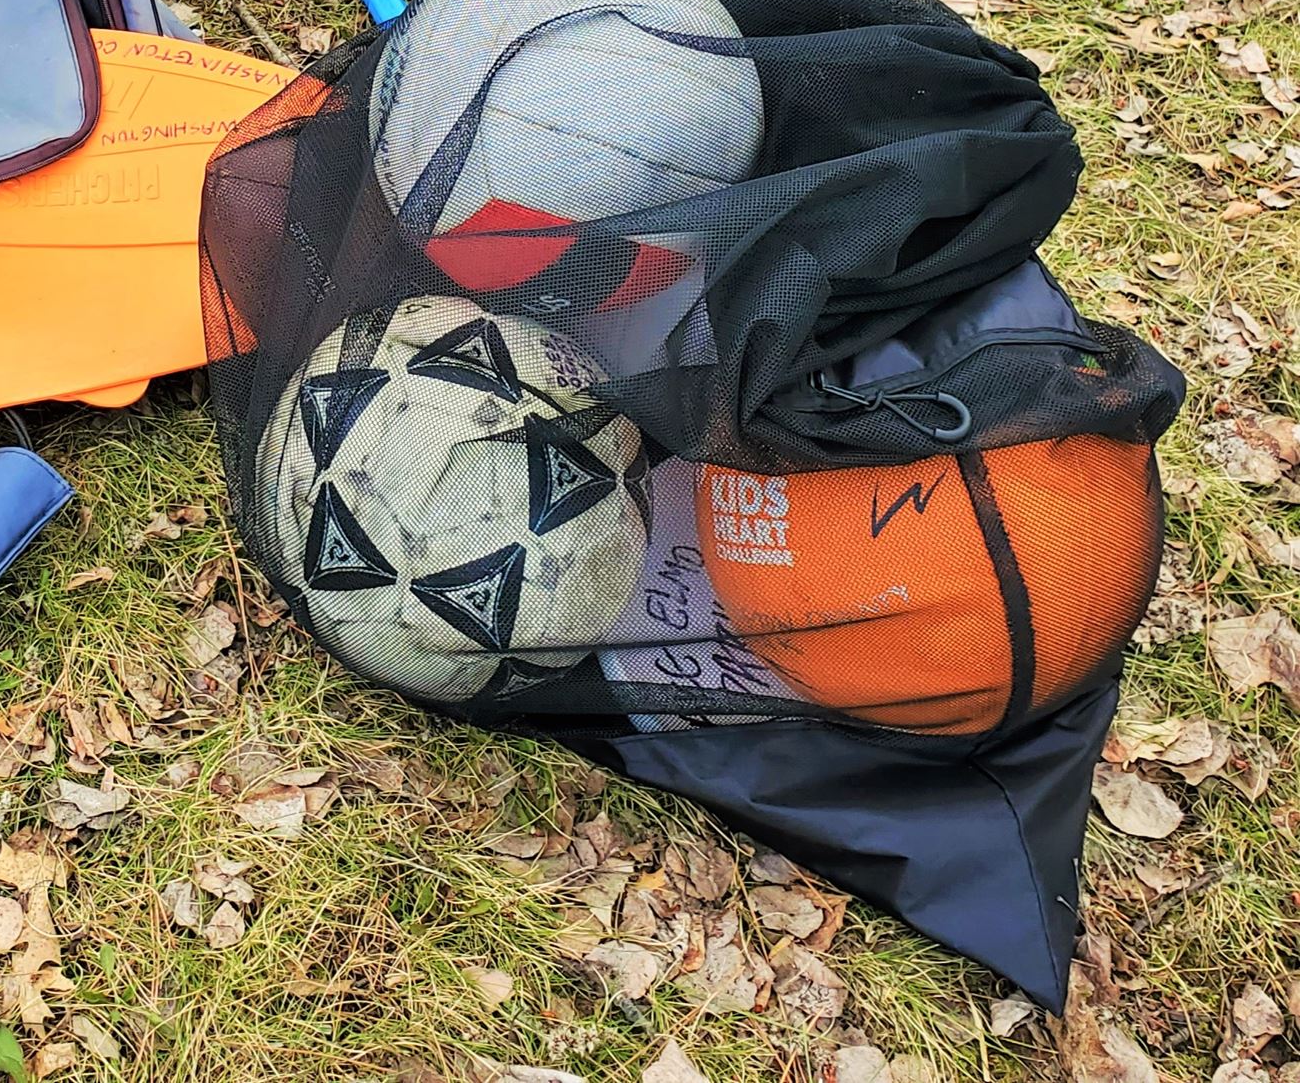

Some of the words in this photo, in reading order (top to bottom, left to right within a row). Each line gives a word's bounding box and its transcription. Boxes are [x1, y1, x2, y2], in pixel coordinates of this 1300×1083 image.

[124, 44, 293, 89] WASHINGTON
[101, 121, 237, 147] WASHINGTON
[710, 474, 792, 518] KIDS
[713, 515, 791, 548] HEART
